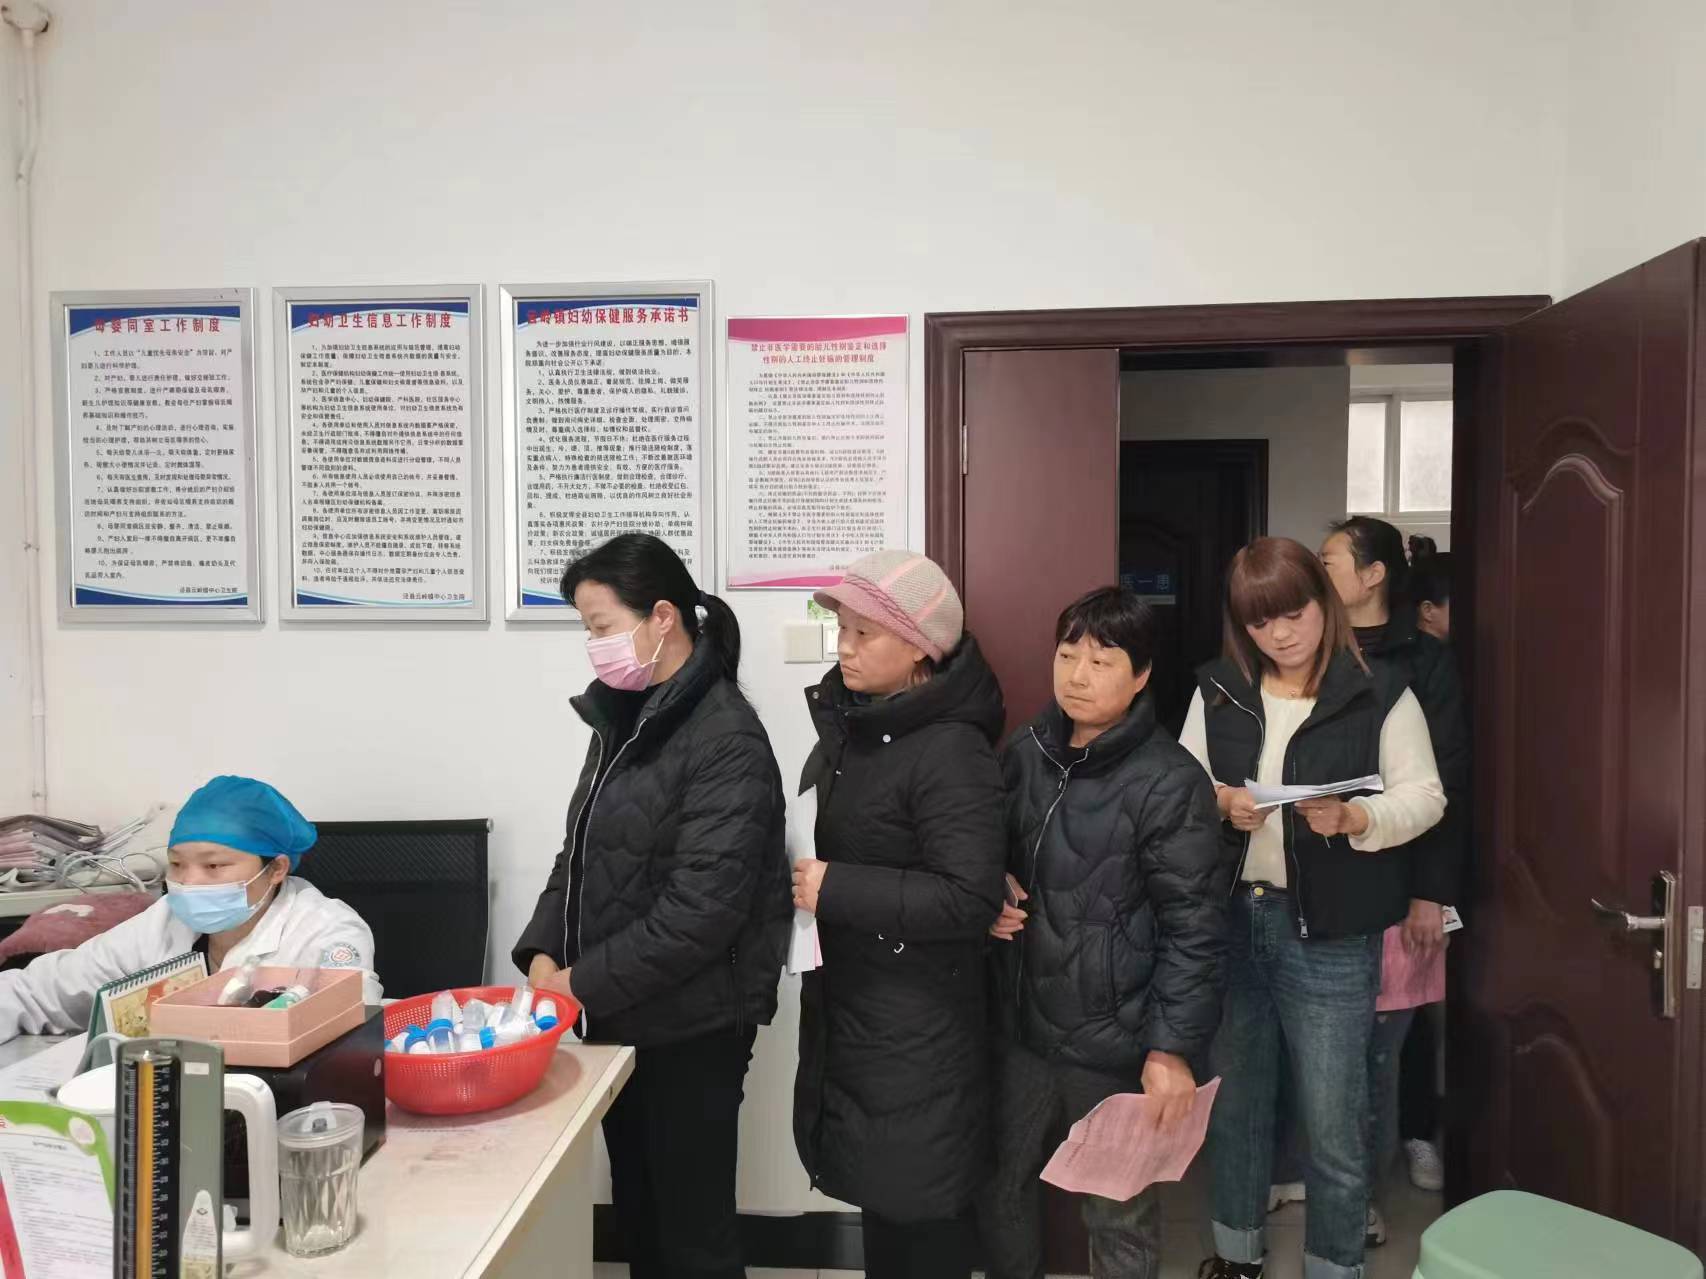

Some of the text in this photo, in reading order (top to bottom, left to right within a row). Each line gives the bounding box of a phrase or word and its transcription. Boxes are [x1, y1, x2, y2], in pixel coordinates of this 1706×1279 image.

[96, 318, 221, 333] 母婴同室工作制度
[308, 313, 451, 328] 妇幼卫生信息工作制度
[751, 343, 887, 352] 禁止非医学需要的胎儿性别鉴定和选择
[763, 354, 874, 364] 性别的人工终止妊娠的管理制度
